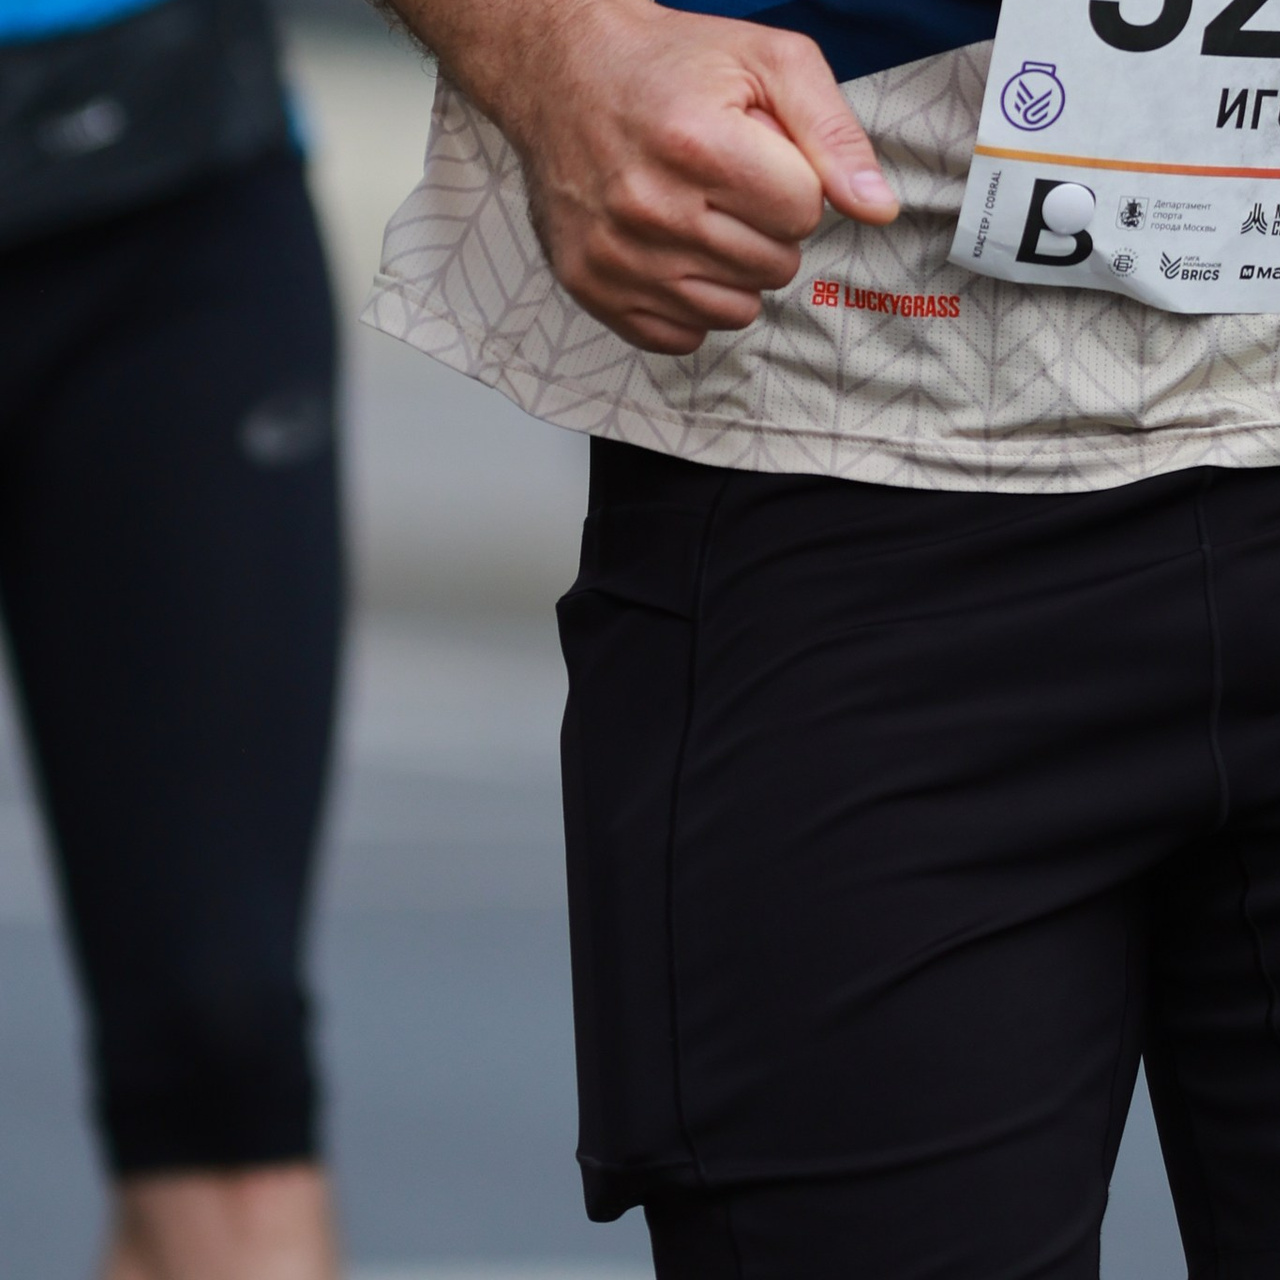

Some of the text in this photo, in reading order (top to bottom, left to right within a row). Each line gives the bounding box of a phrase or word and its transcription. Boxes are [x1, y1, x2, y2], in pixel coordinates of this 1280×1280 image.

[1154, 200, 1211, 211] Департамент
[972, 217, 991, 259] КЛАСТЕР
[985, 170, 1002, 209] CORRAL
[1152, 211, 1183, 221] спорта
[1183, 223, 1217, 232] Москвы
[1181, 269, 1220, 281] BRICS
[844, 285, 961, 318] LUCKYGRASS
